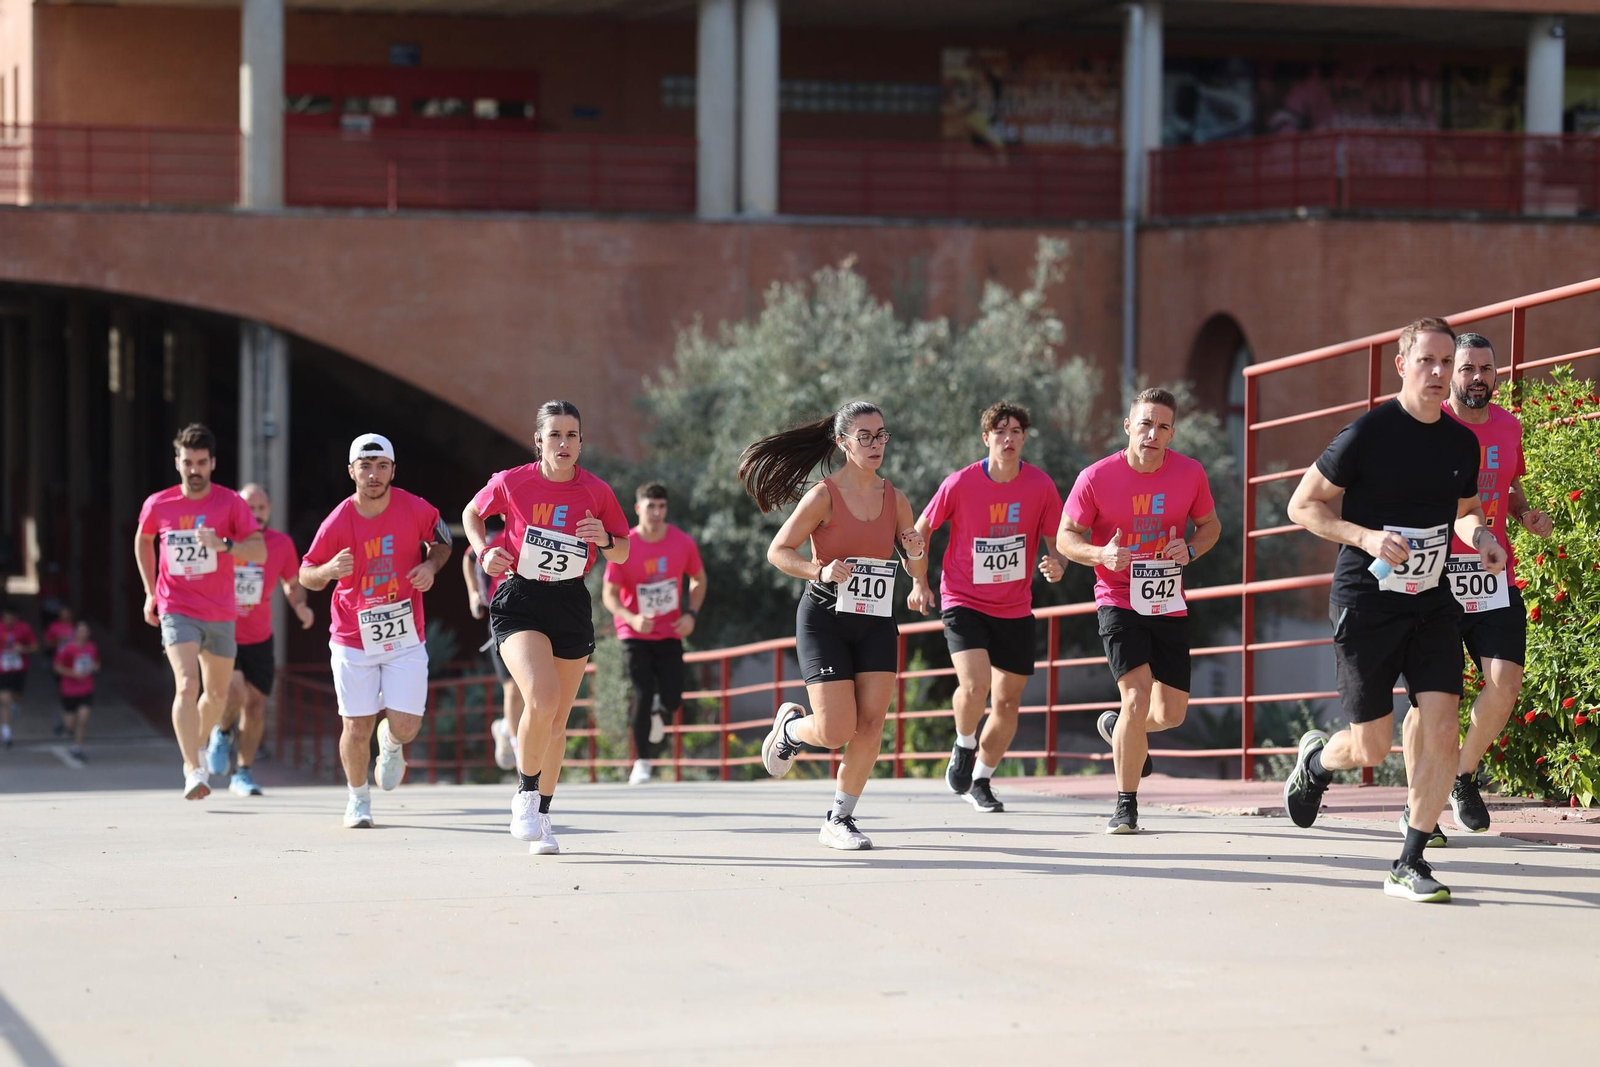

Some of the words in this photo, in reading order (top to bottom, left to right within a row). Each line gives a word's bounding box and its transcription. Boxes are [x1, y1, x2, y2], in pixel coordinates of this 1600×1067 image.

[989, 502, 1021, 524] WE
[1132, 493, 1165, 516] WE
[179, 515, 207, 530] WE
[532, 503, 569, 527] WE
[364, 534, 394, 560] WE
[528, 534, 556, 549] UMA
[976, 545, 1001, 553] UMA
[174, 546, 209, 562] 224
[537, 550, 569, 573] 23
[983, 552, 1019, 570] 404
[1394, 550, 1439, 576] 327
[852, 565, 868, 573] MA
[1133, 569, 1161, 577] UMA
[1447, 562, 1474, 572] UMA
[236, 583, 256, 595] 66
[847, 576, 887, 600] 410
[1141, 578, 1175, 600] 642
[1455, 574, 1498, 597] 500
[362, 613, 388, 623] UMA
[370, 618, 408, 641] 321
